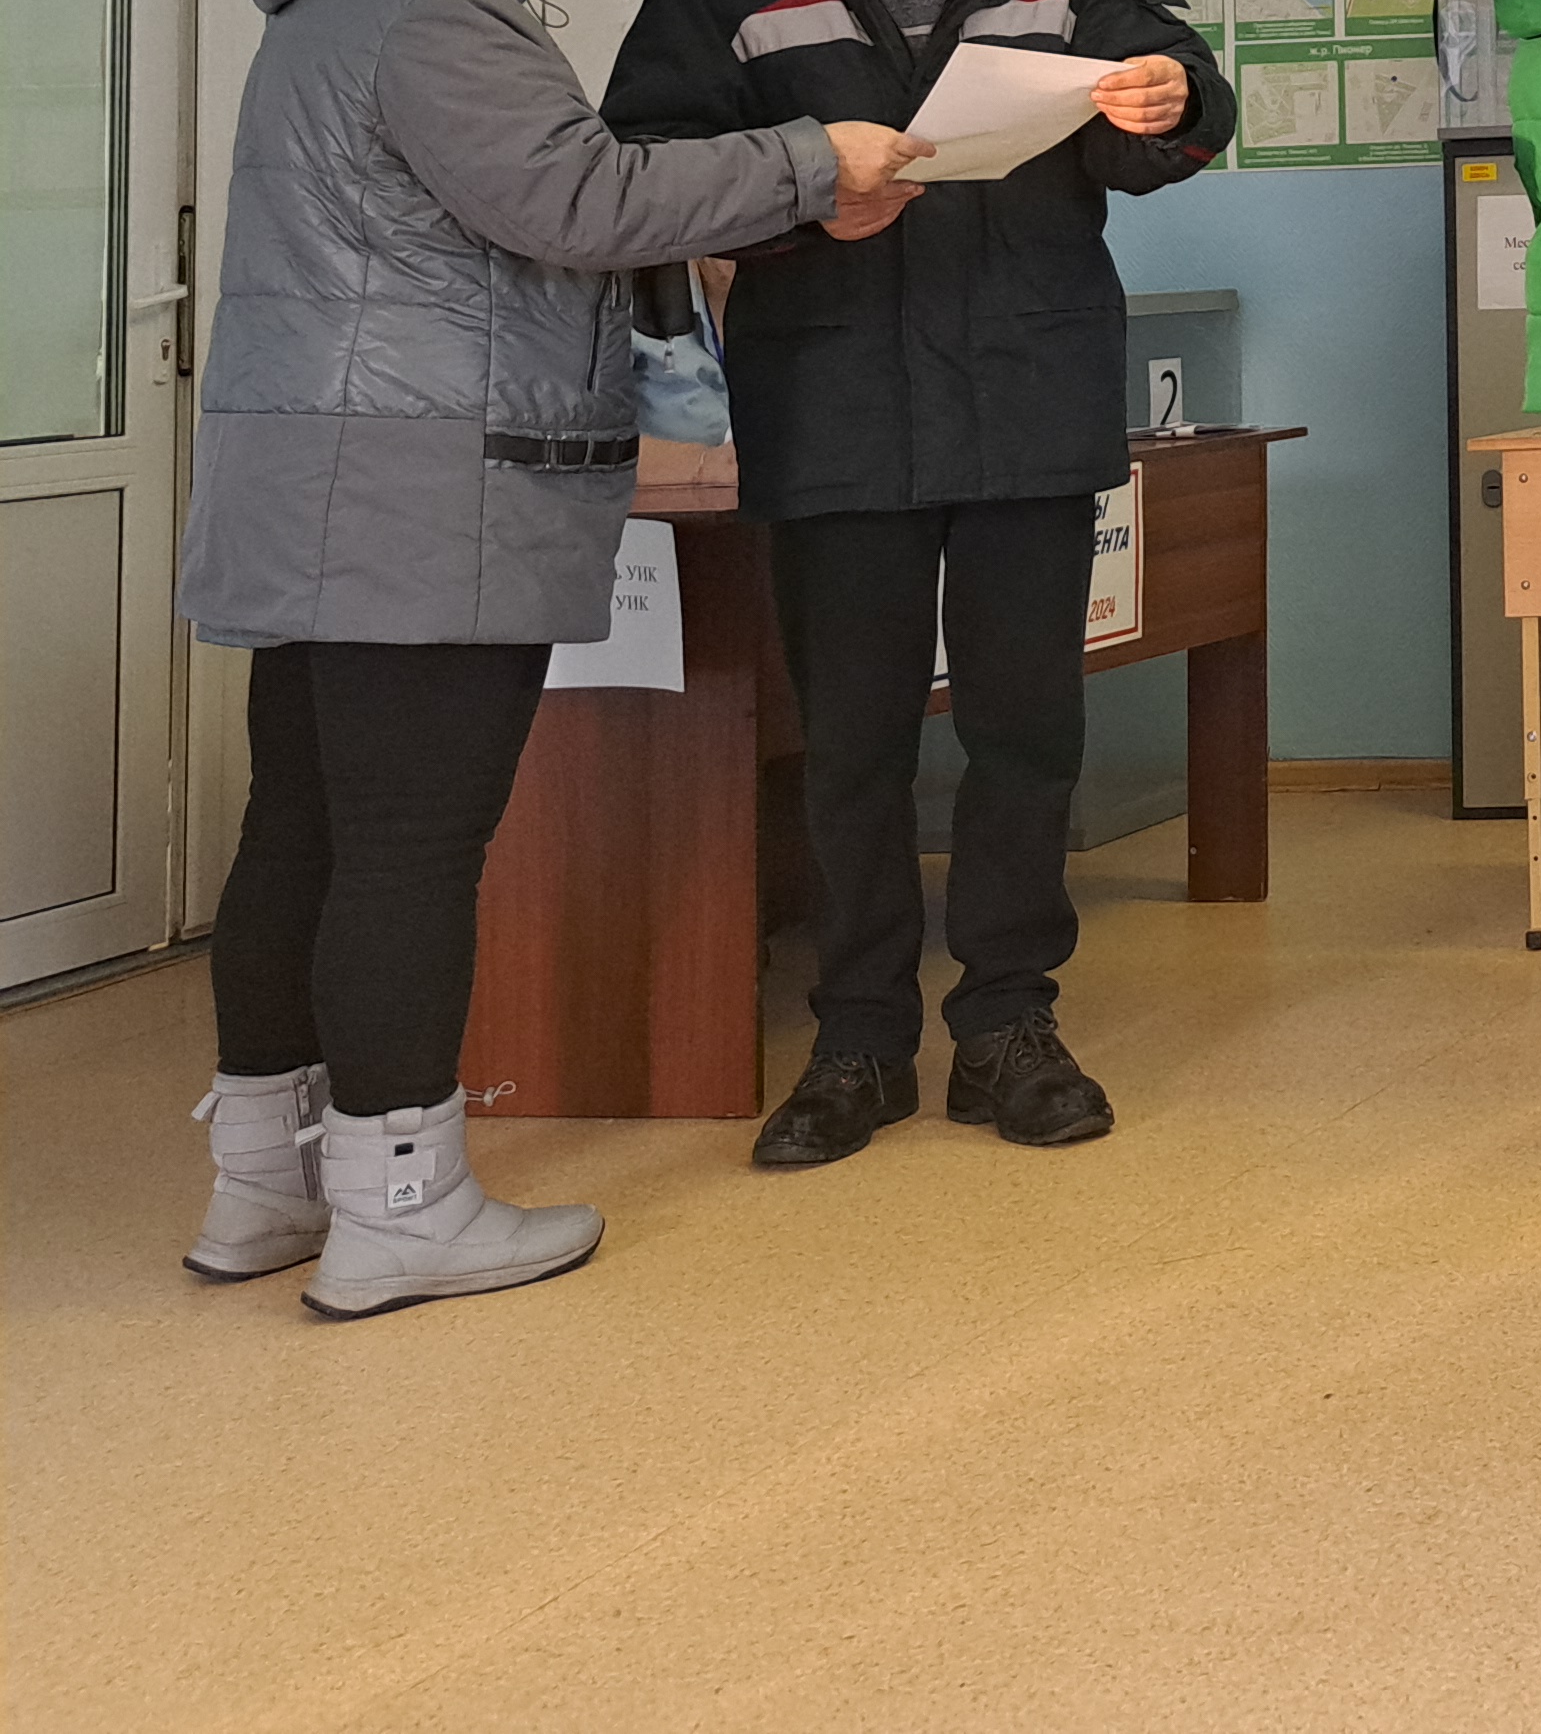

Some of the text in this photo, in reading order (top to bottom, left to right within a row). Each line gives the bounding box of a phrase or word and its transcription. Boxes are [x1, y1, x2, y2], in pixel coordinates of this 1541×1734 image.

[1332, 44, 1373, 57] Пионер
[625, 565, 658, 583] УИК
[615, 595, 649, 611] УИК
[1088, 596, 1116, 622] 2024
